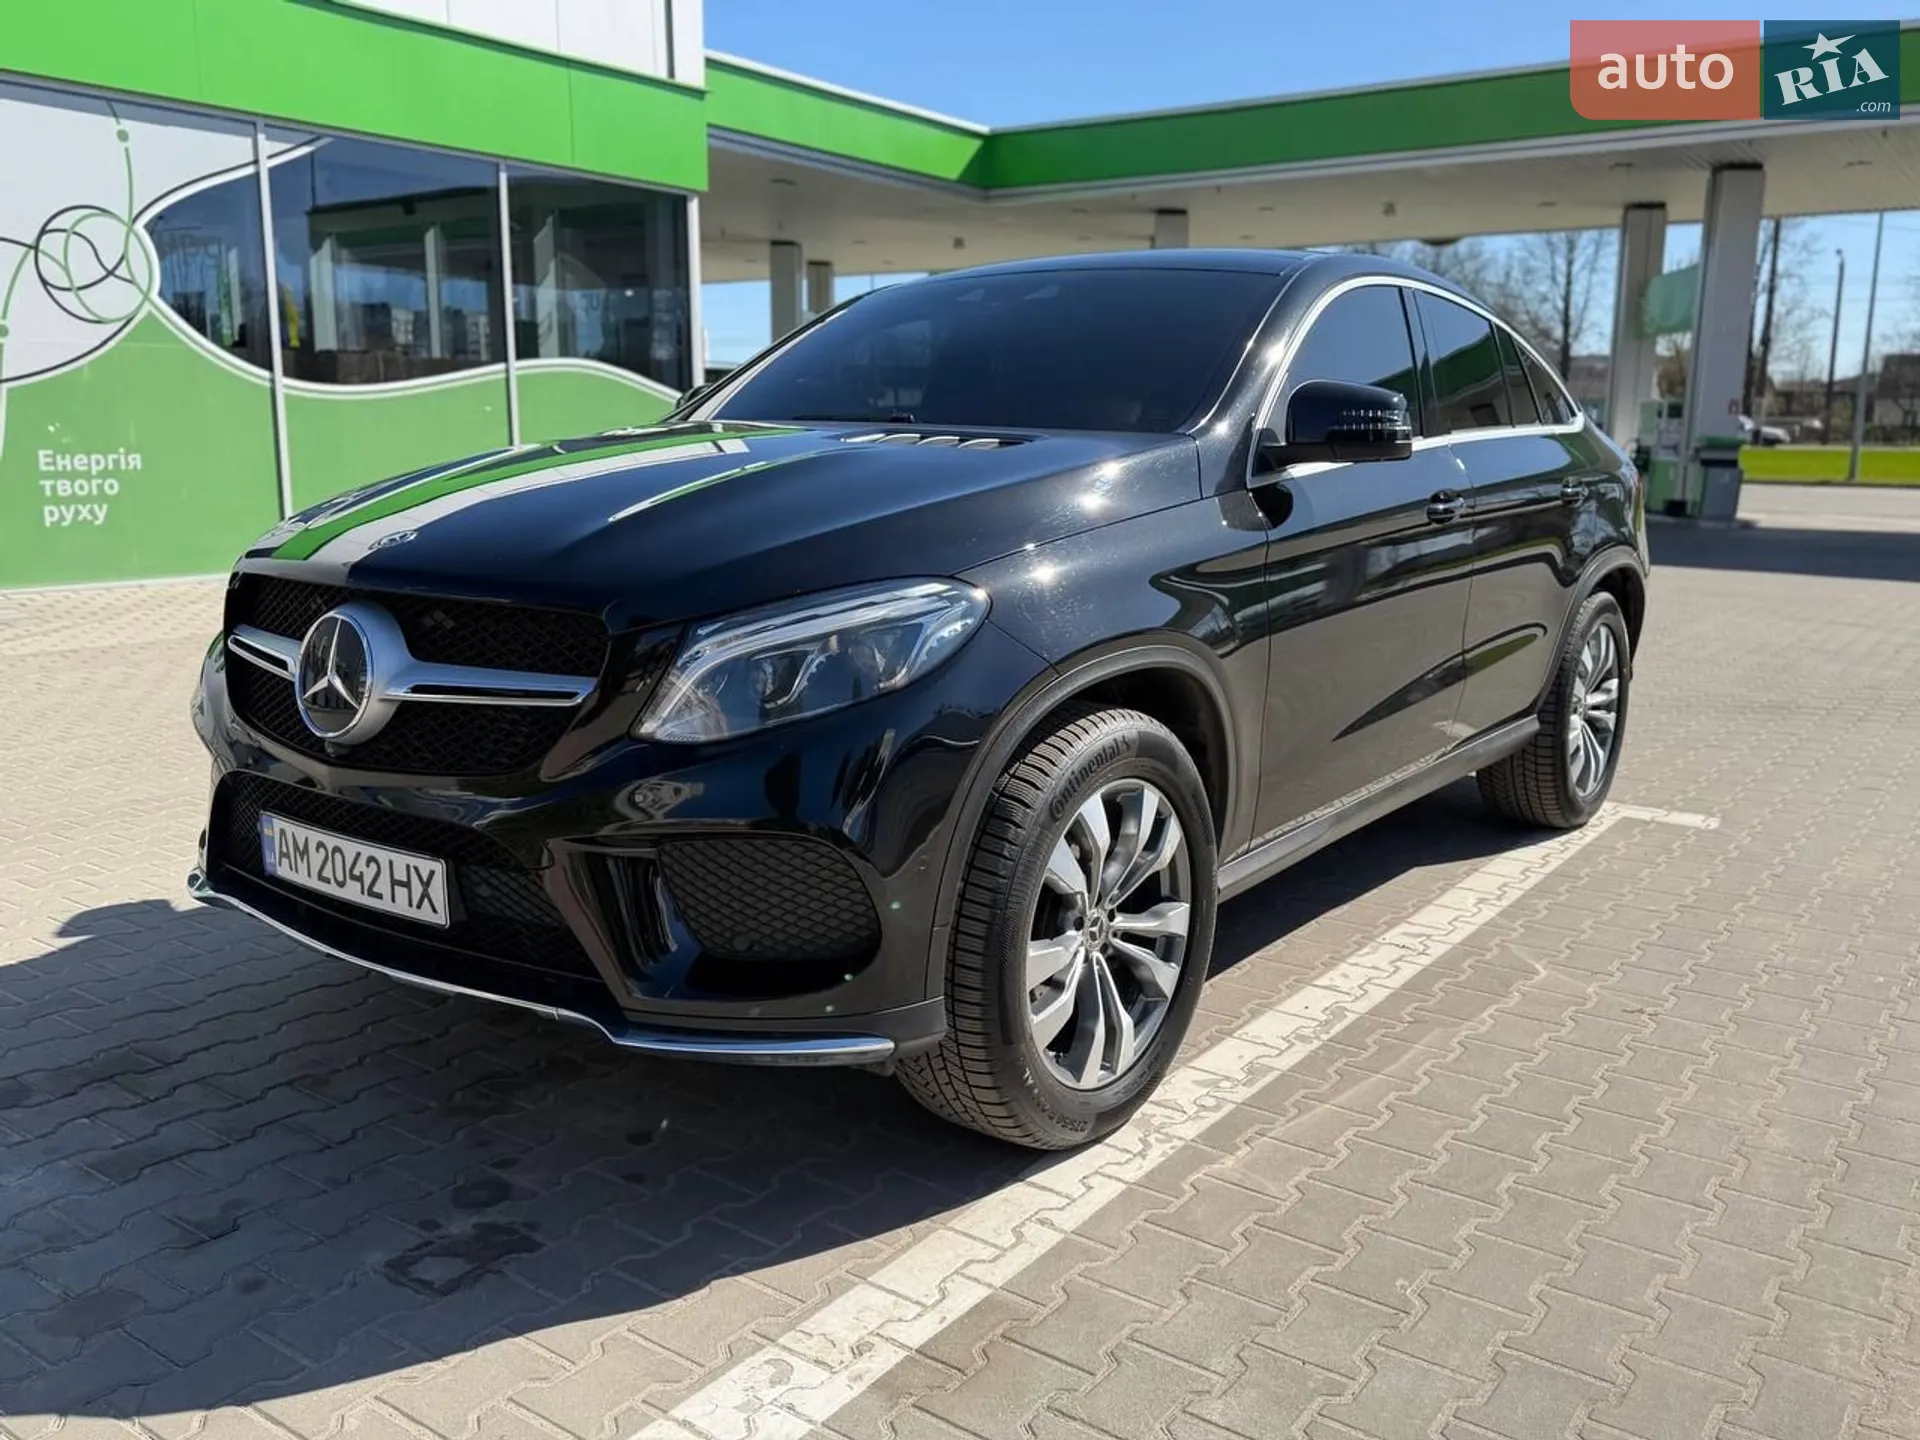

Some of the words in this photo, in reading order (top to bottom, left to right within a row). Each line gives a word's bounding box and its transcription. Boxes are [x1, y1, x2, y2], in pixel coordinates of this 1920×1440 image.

[37, 447, 142, 476] Енергія
[39, 478, 120, 497] твого
[43, 503, 108, 528] руху
